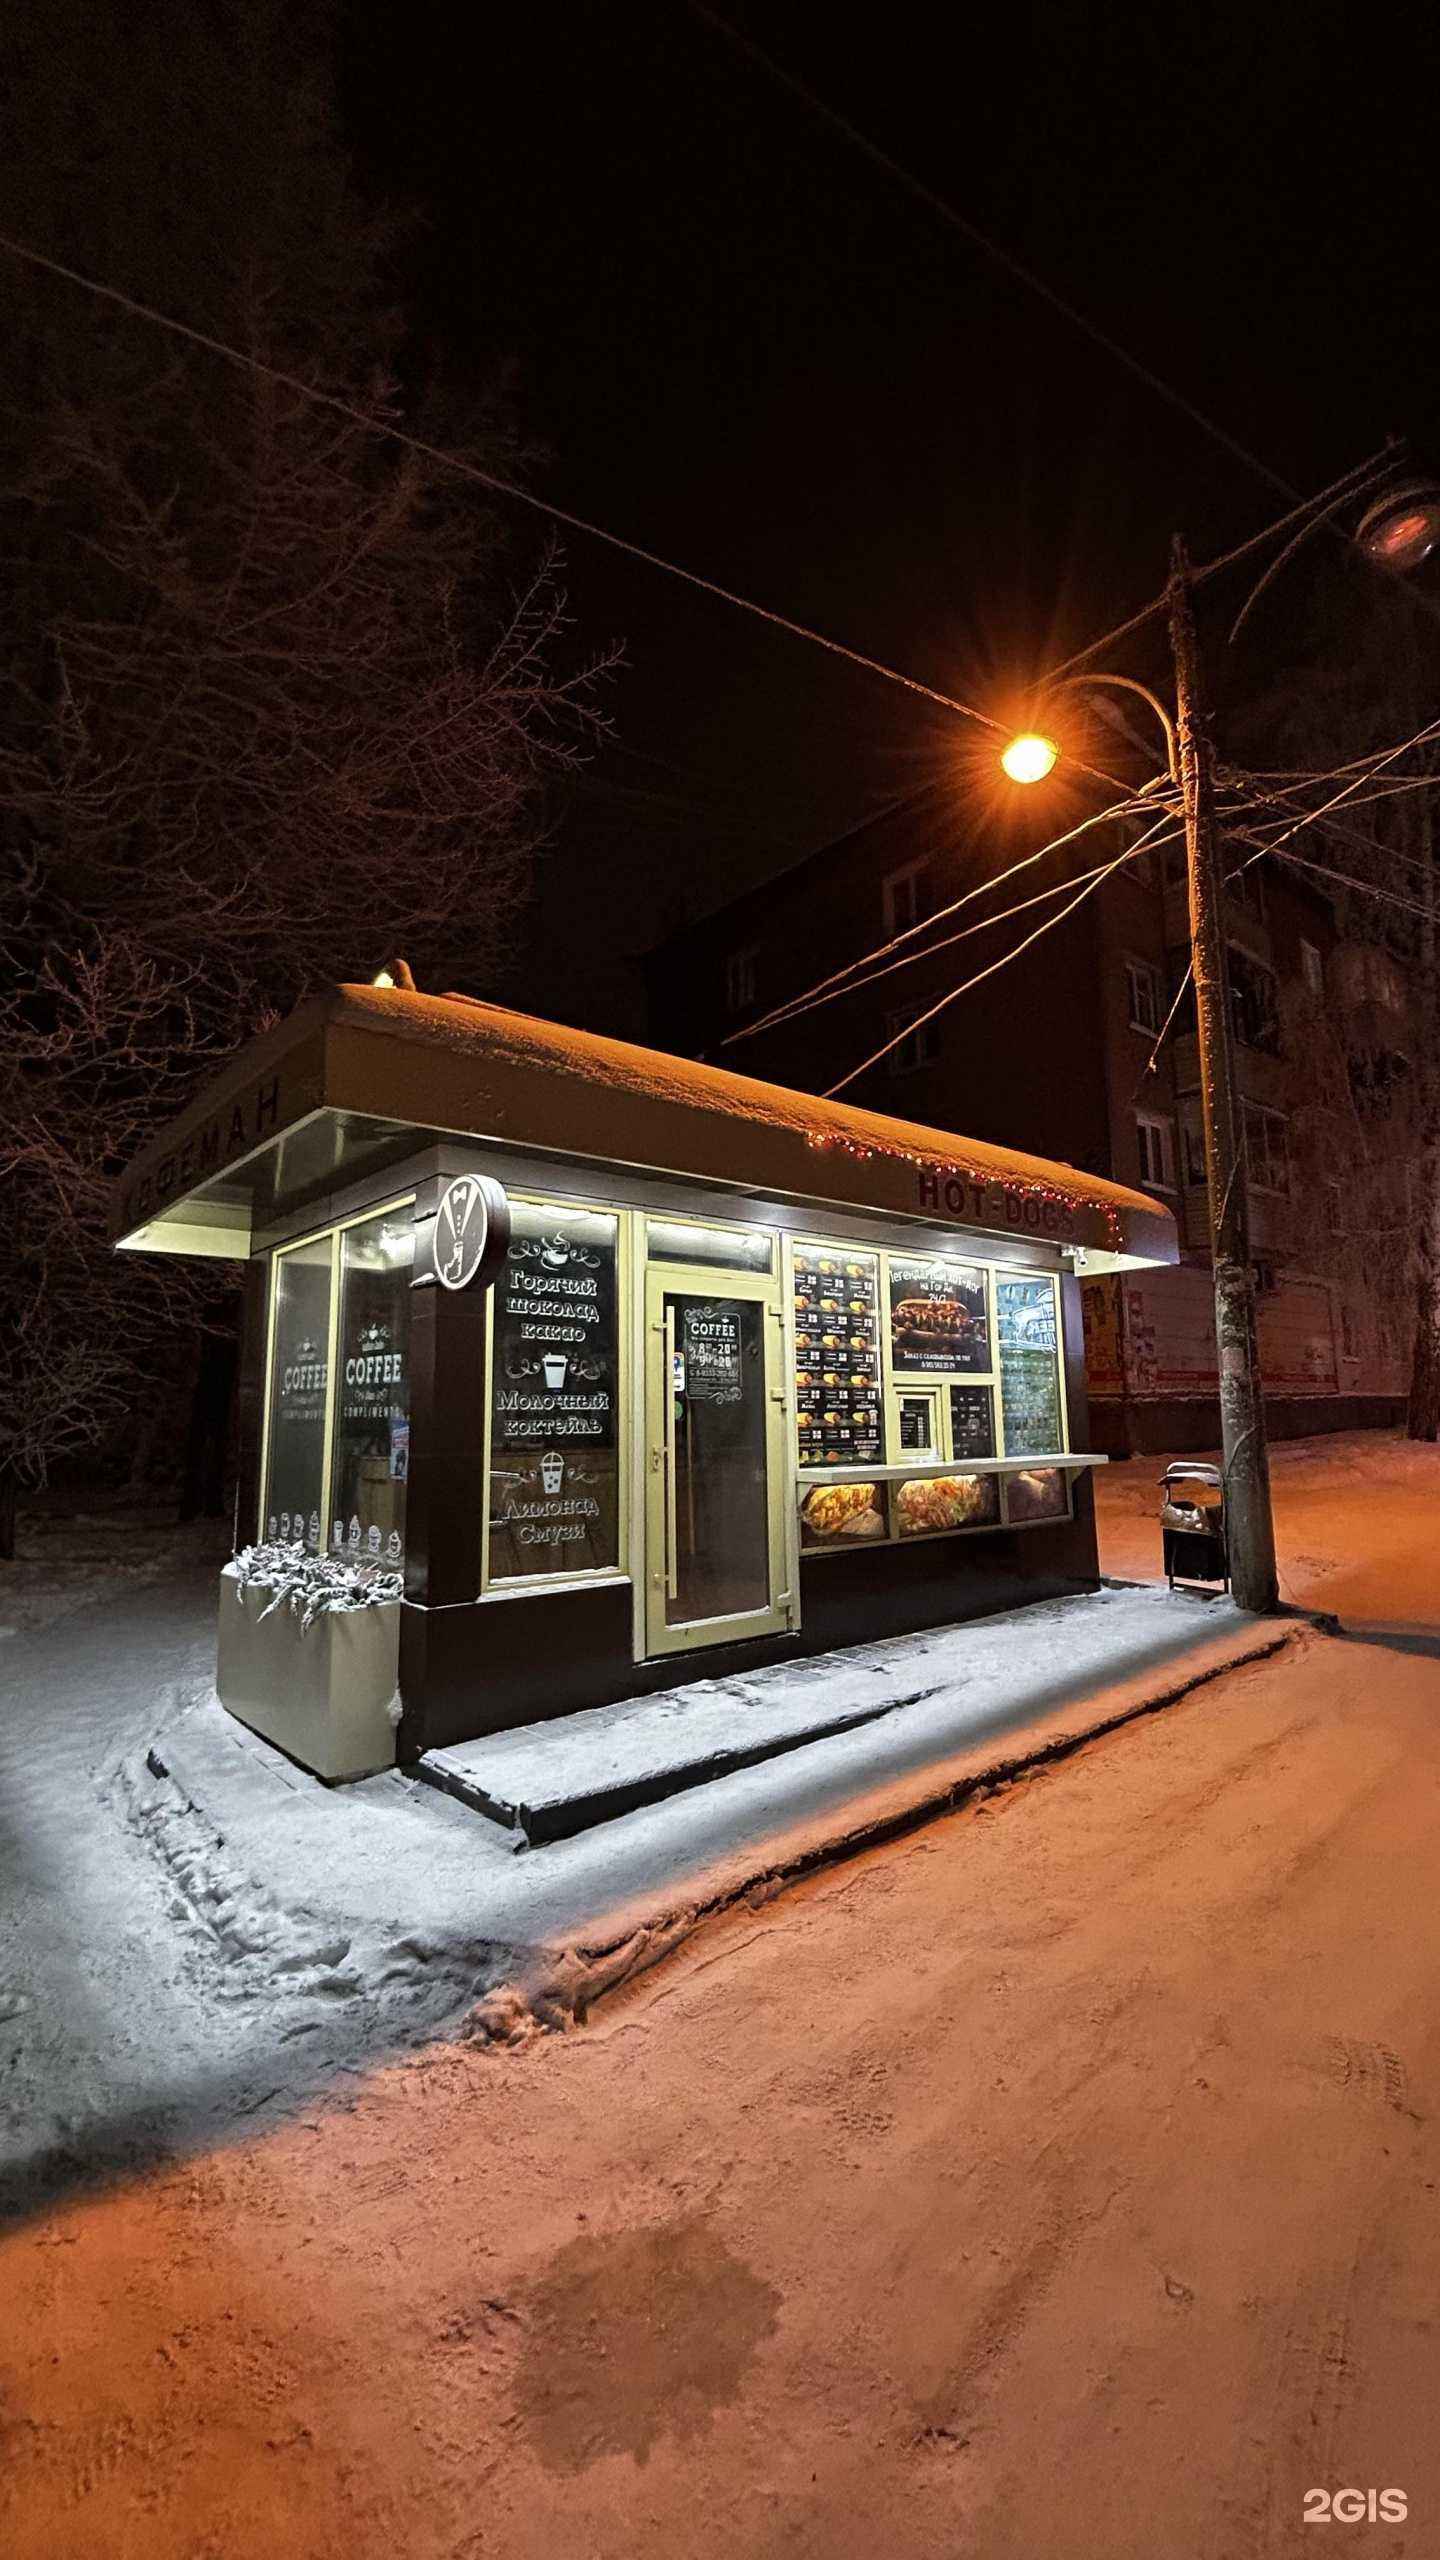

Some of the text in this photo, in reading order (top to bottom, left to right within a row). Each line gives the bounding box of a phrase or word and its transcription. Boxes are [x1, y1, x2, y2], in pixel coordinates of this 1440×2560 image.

[918, 1172, 1074, 1233] HOT-DOGS
[510, 1269, 598, 1297] Горячий
[506, 1297, 600, 1323] шоколад
[521, 1322, 586, 1342] какао
[691, 1323, 736, 1337] COFFEE
[284, 1364, 328, 1391] COFFEE
[345, 1353, 402, 1386] COFFEE
[496, 1390, 610, 1411] Молочный
[503, 1416, 603, 1436] коктейль
[502, 1498, 600, 1520] Лимонад
[520, 1522, 586, 1547] Смузи
